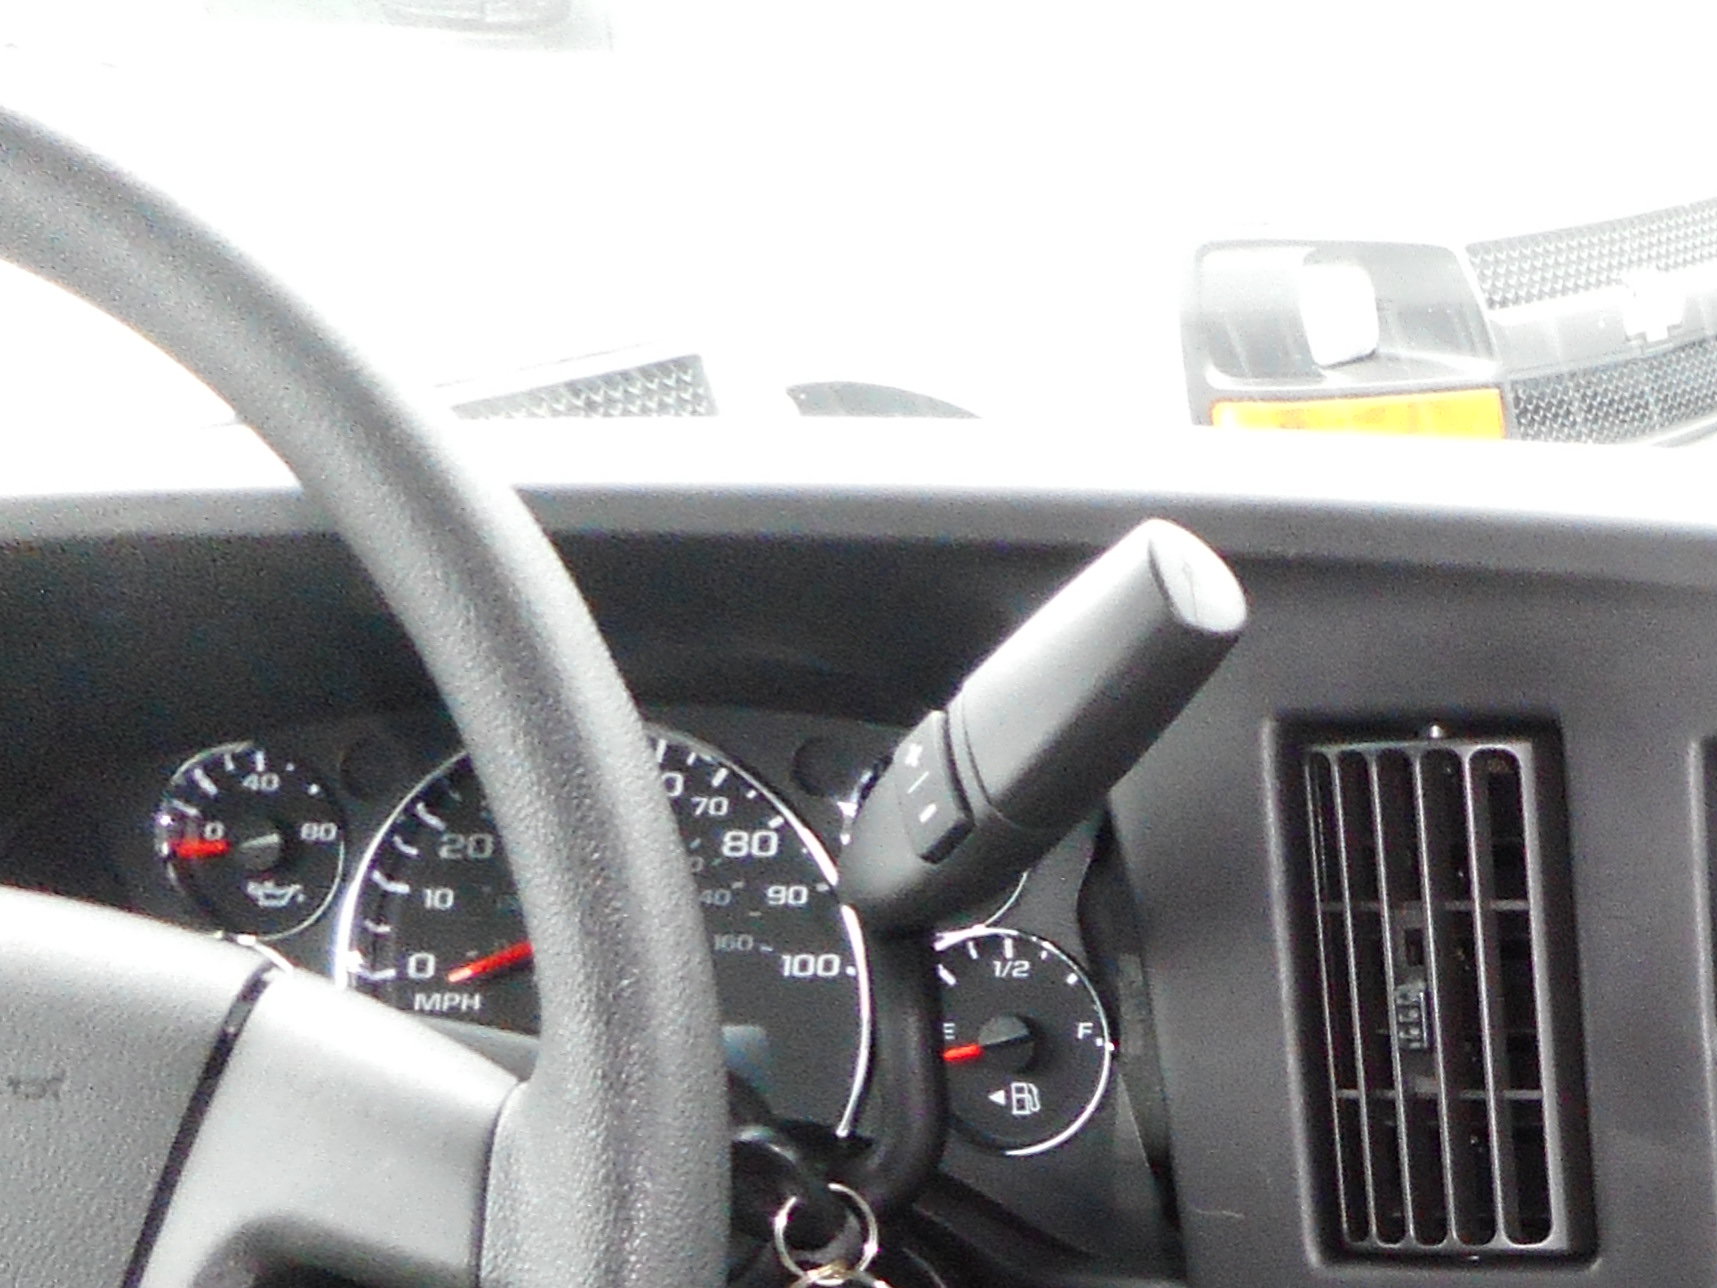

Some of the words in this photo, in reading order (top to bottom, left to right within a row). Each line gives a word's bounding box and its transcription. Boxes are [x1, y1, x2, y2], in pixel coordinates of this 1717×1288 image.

[243, 773, 279, 791] 40
[660, 772, 684, 797] 0
[692, 797, 728, 815] 70
[204, 822, 224, 840] 0
[438, 833, 494, 859] 20
[722, 830, 778, 857] 80
[424, 888, 453, 910] 10
[699, 889, 731, 905] 40
[767, 886, 808, 905] 90
[714, 935, 754, 951] 160
[407, 953, 435, 978] 0
[782, 954, 840, 977] 100
[993, 956, 1030, 977] 1/2
[413, 993, 482, 1012] MPH
[944, 1023, 955, 1039] E
[1078, 1022, 1093, 1039] F
